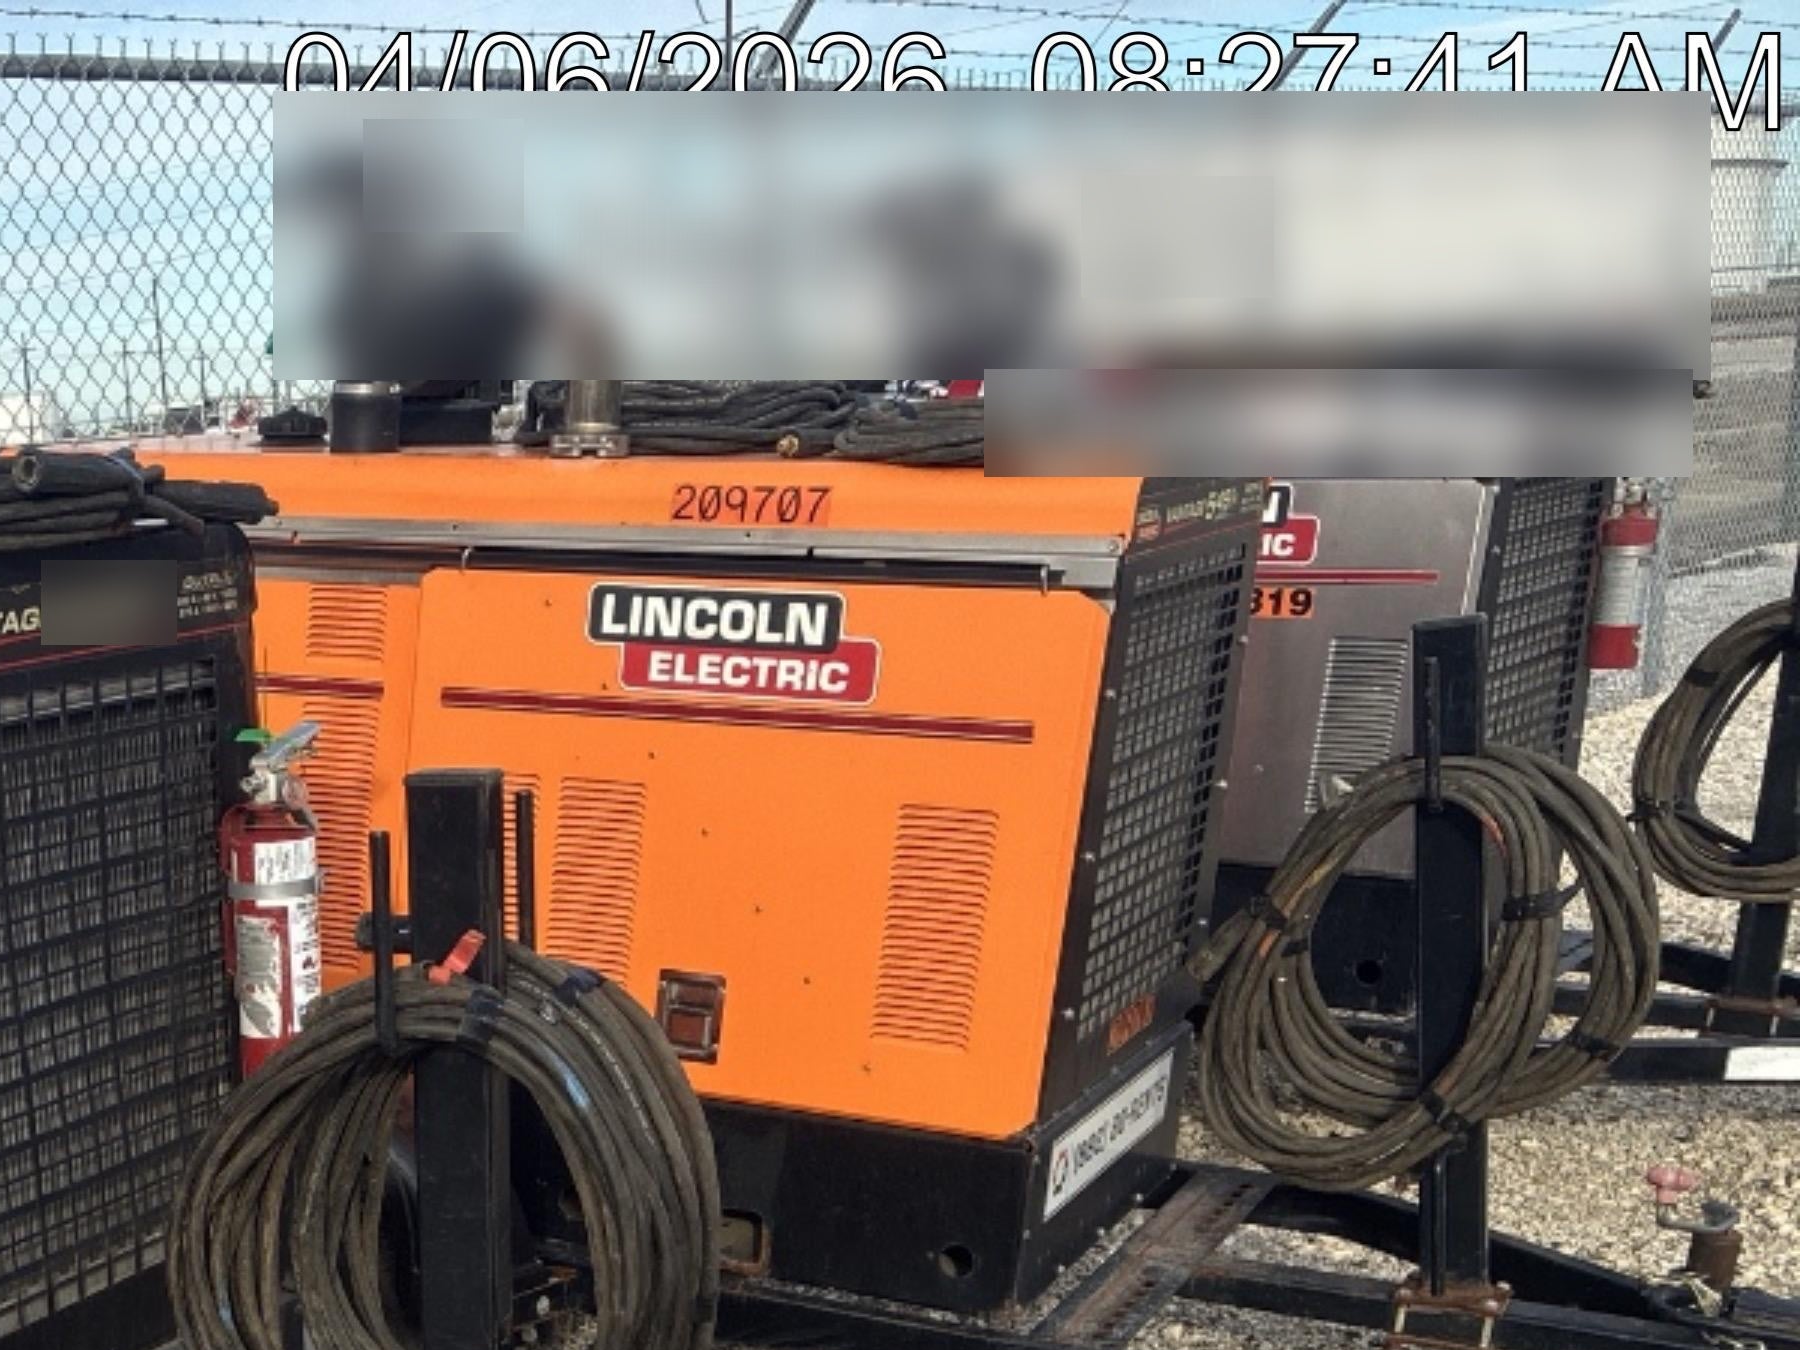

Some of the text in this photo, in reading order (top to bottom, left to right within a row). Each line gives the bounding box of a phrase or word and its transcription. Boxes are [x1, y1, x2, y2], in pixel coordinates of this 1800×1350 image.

[672, 485, 832, 523] 209707
[601, 593, 829, 646] LINCOLN
[648, 650, 850, 693] ELECTRIC
